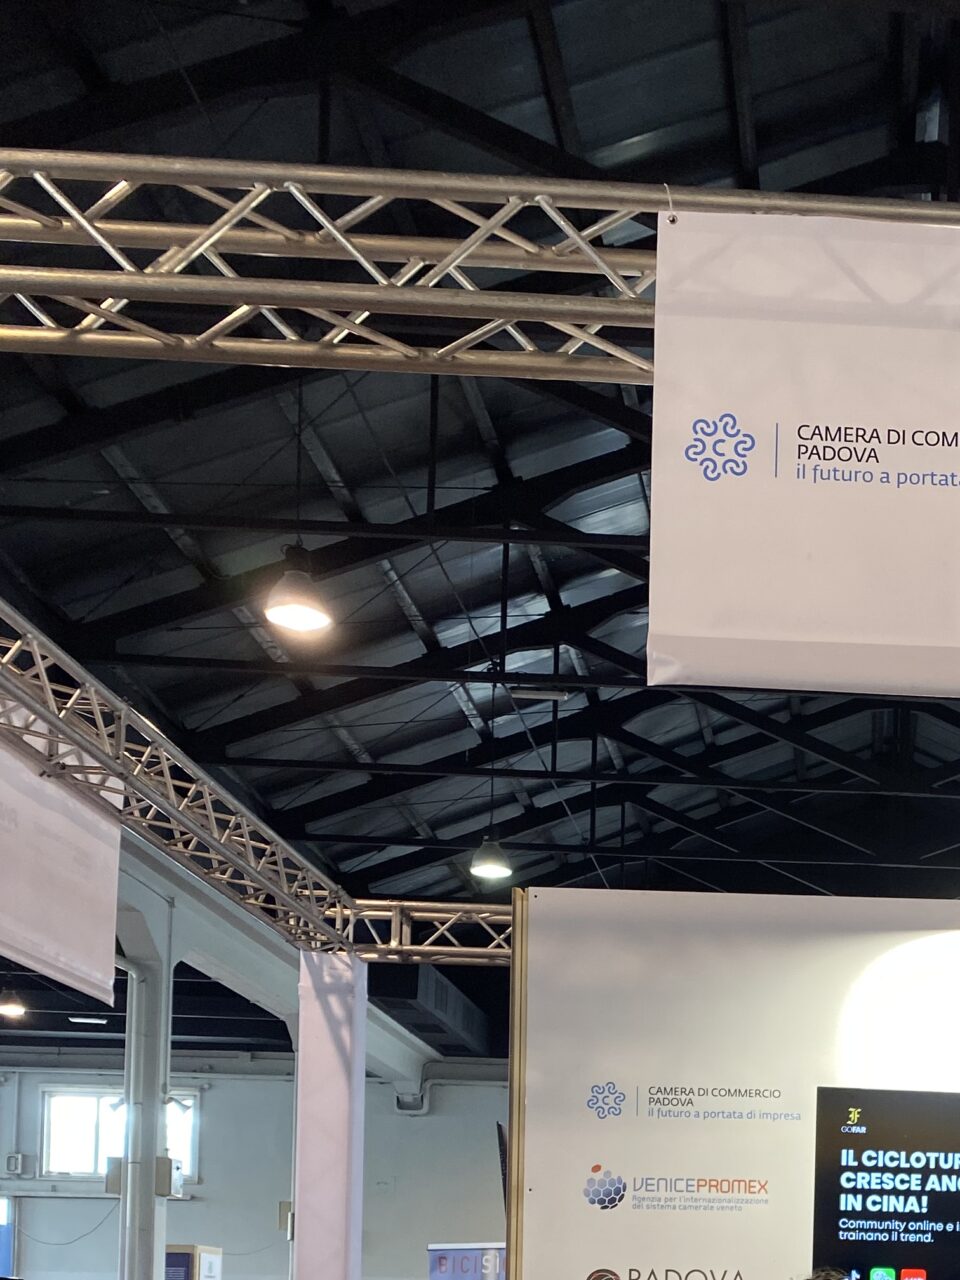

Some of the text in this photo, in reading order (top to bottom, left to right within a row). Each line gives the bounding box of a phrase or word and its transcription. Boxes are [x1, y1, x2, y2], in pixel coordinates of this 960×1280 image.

[797, 424, 882, 445] CAMERA
[887, 429, 907, 446] DI
[797, 444, 880, 464] PADOVA
[796, 464, 807, 481] il
[812, 464, 875, 485] futuro
[879, 472, 892, 485] a
[648, 1086, 782, 1099] CAMERA DI COMMERCIO
[648, 1096, 694, 1107] PADOVA
[647, 1107, 801, 1123] il futuro a portata di impresa
[840, 1149, 859, 1167] IL
[632, 1177, 769, 1195] VENICEPROMEX
[839, 1172, 922, 1192] CRESCE
[839, 1193, 928, 1214] IN CINA!
[838, 1218, 907, 1233] Community
[908, 1220, 944, 1232] online
[946, 1223, 954, 1232] e
[838, 1229, 934, 1243] trainano il trend.
